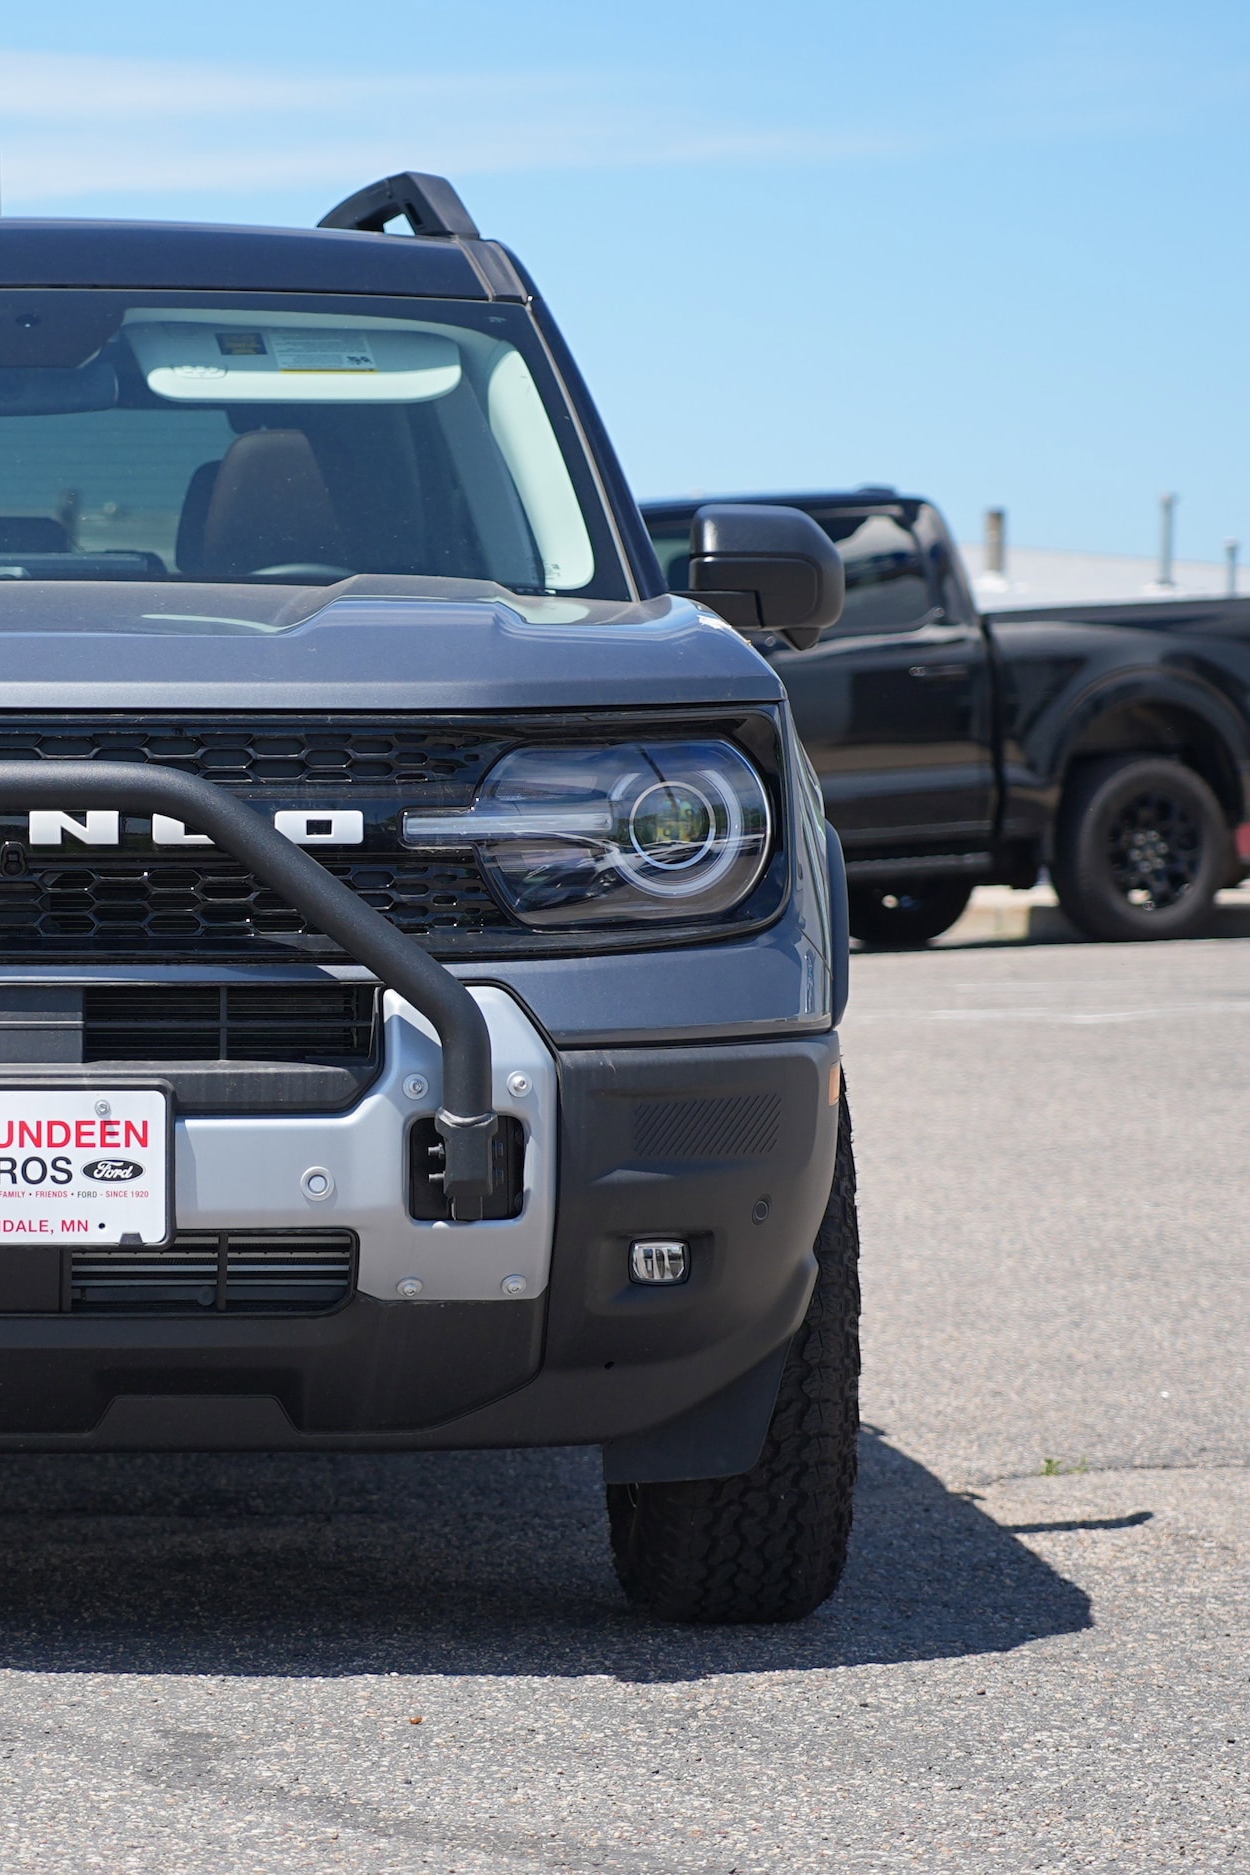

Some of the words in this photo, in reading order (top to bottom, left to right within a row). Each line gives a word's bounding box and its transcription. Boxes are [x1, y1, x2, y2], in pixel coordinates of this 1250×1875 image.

[93, 1160, 134, 1179] Ford
[35, 1190, 68, 1199] FRIENDS
[77, 1190, 98, 1199] FORD
[105, 1190, 128, 1199] SINCE
[131, 1190, 149, 1199] 1920
[61, 1219, 89, 1233] MN
